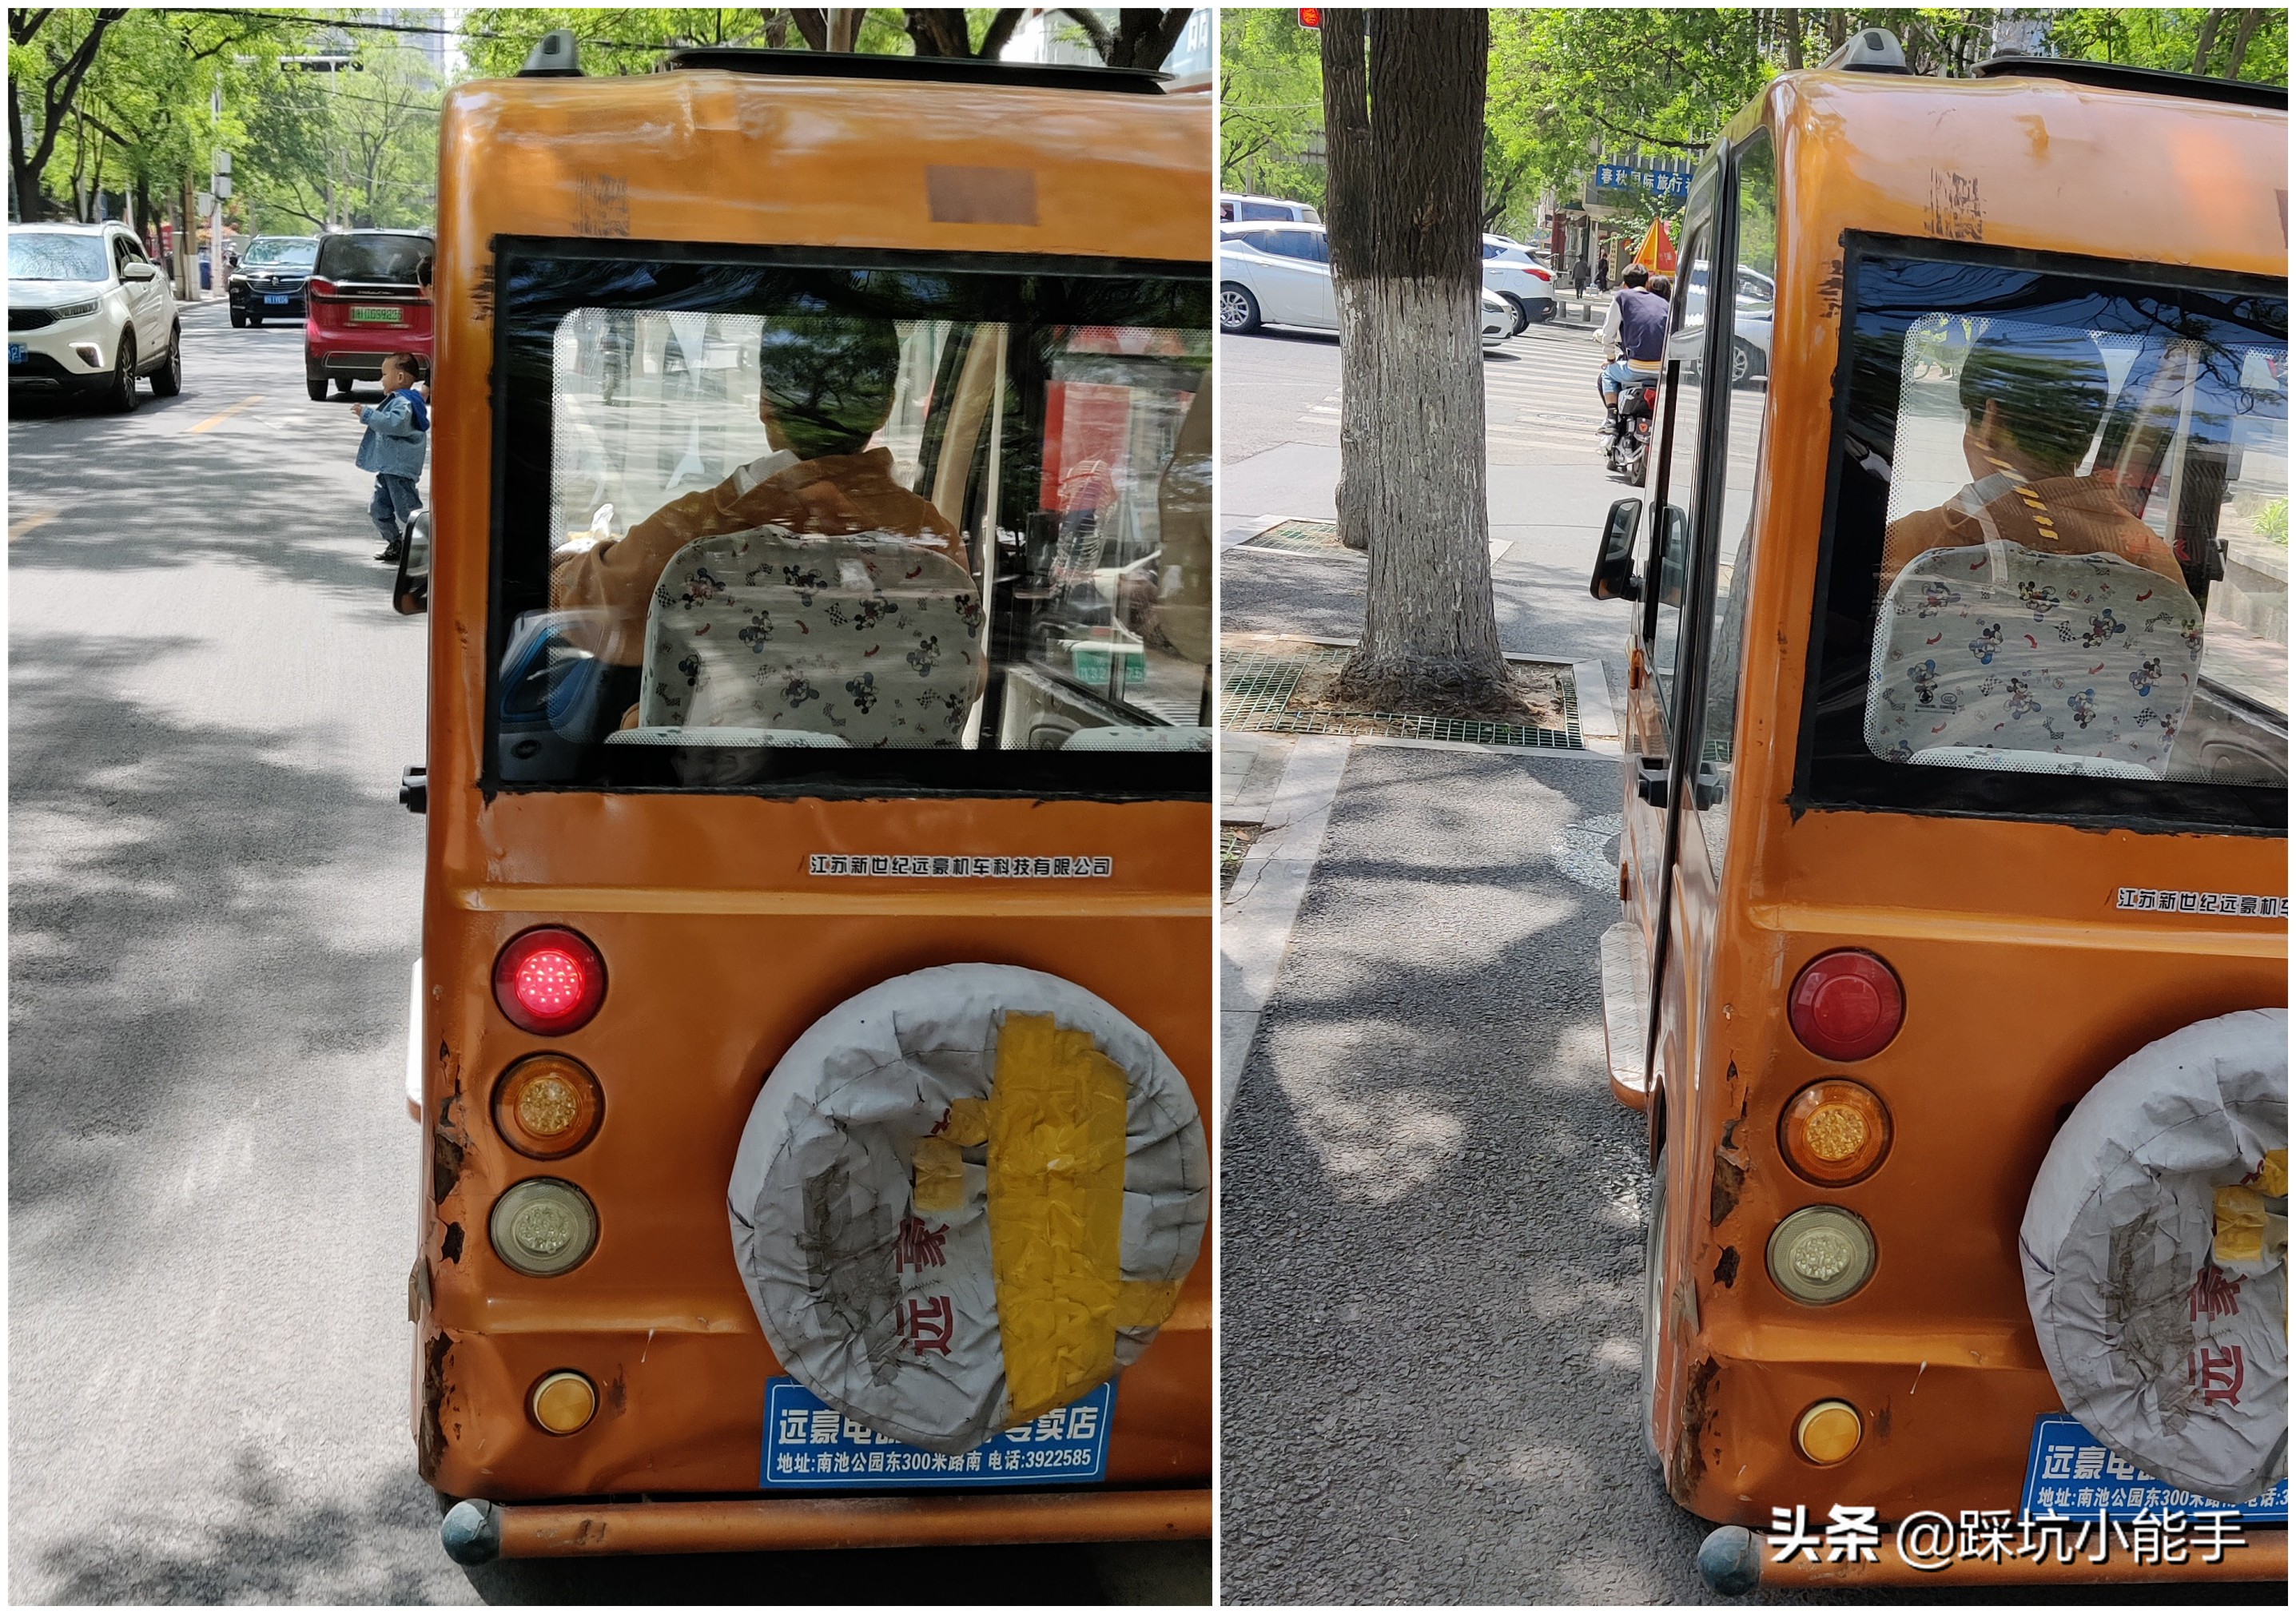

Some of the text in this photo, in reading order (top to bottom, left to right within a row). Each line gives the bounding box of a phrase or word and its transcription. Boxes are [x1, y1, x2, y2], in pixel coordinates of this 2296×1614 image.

[810, 855, 1112, 876] 江苏新世纪远豪机车科技有限公司
[989, 1449, 1091, 1470] 电话:3922585
